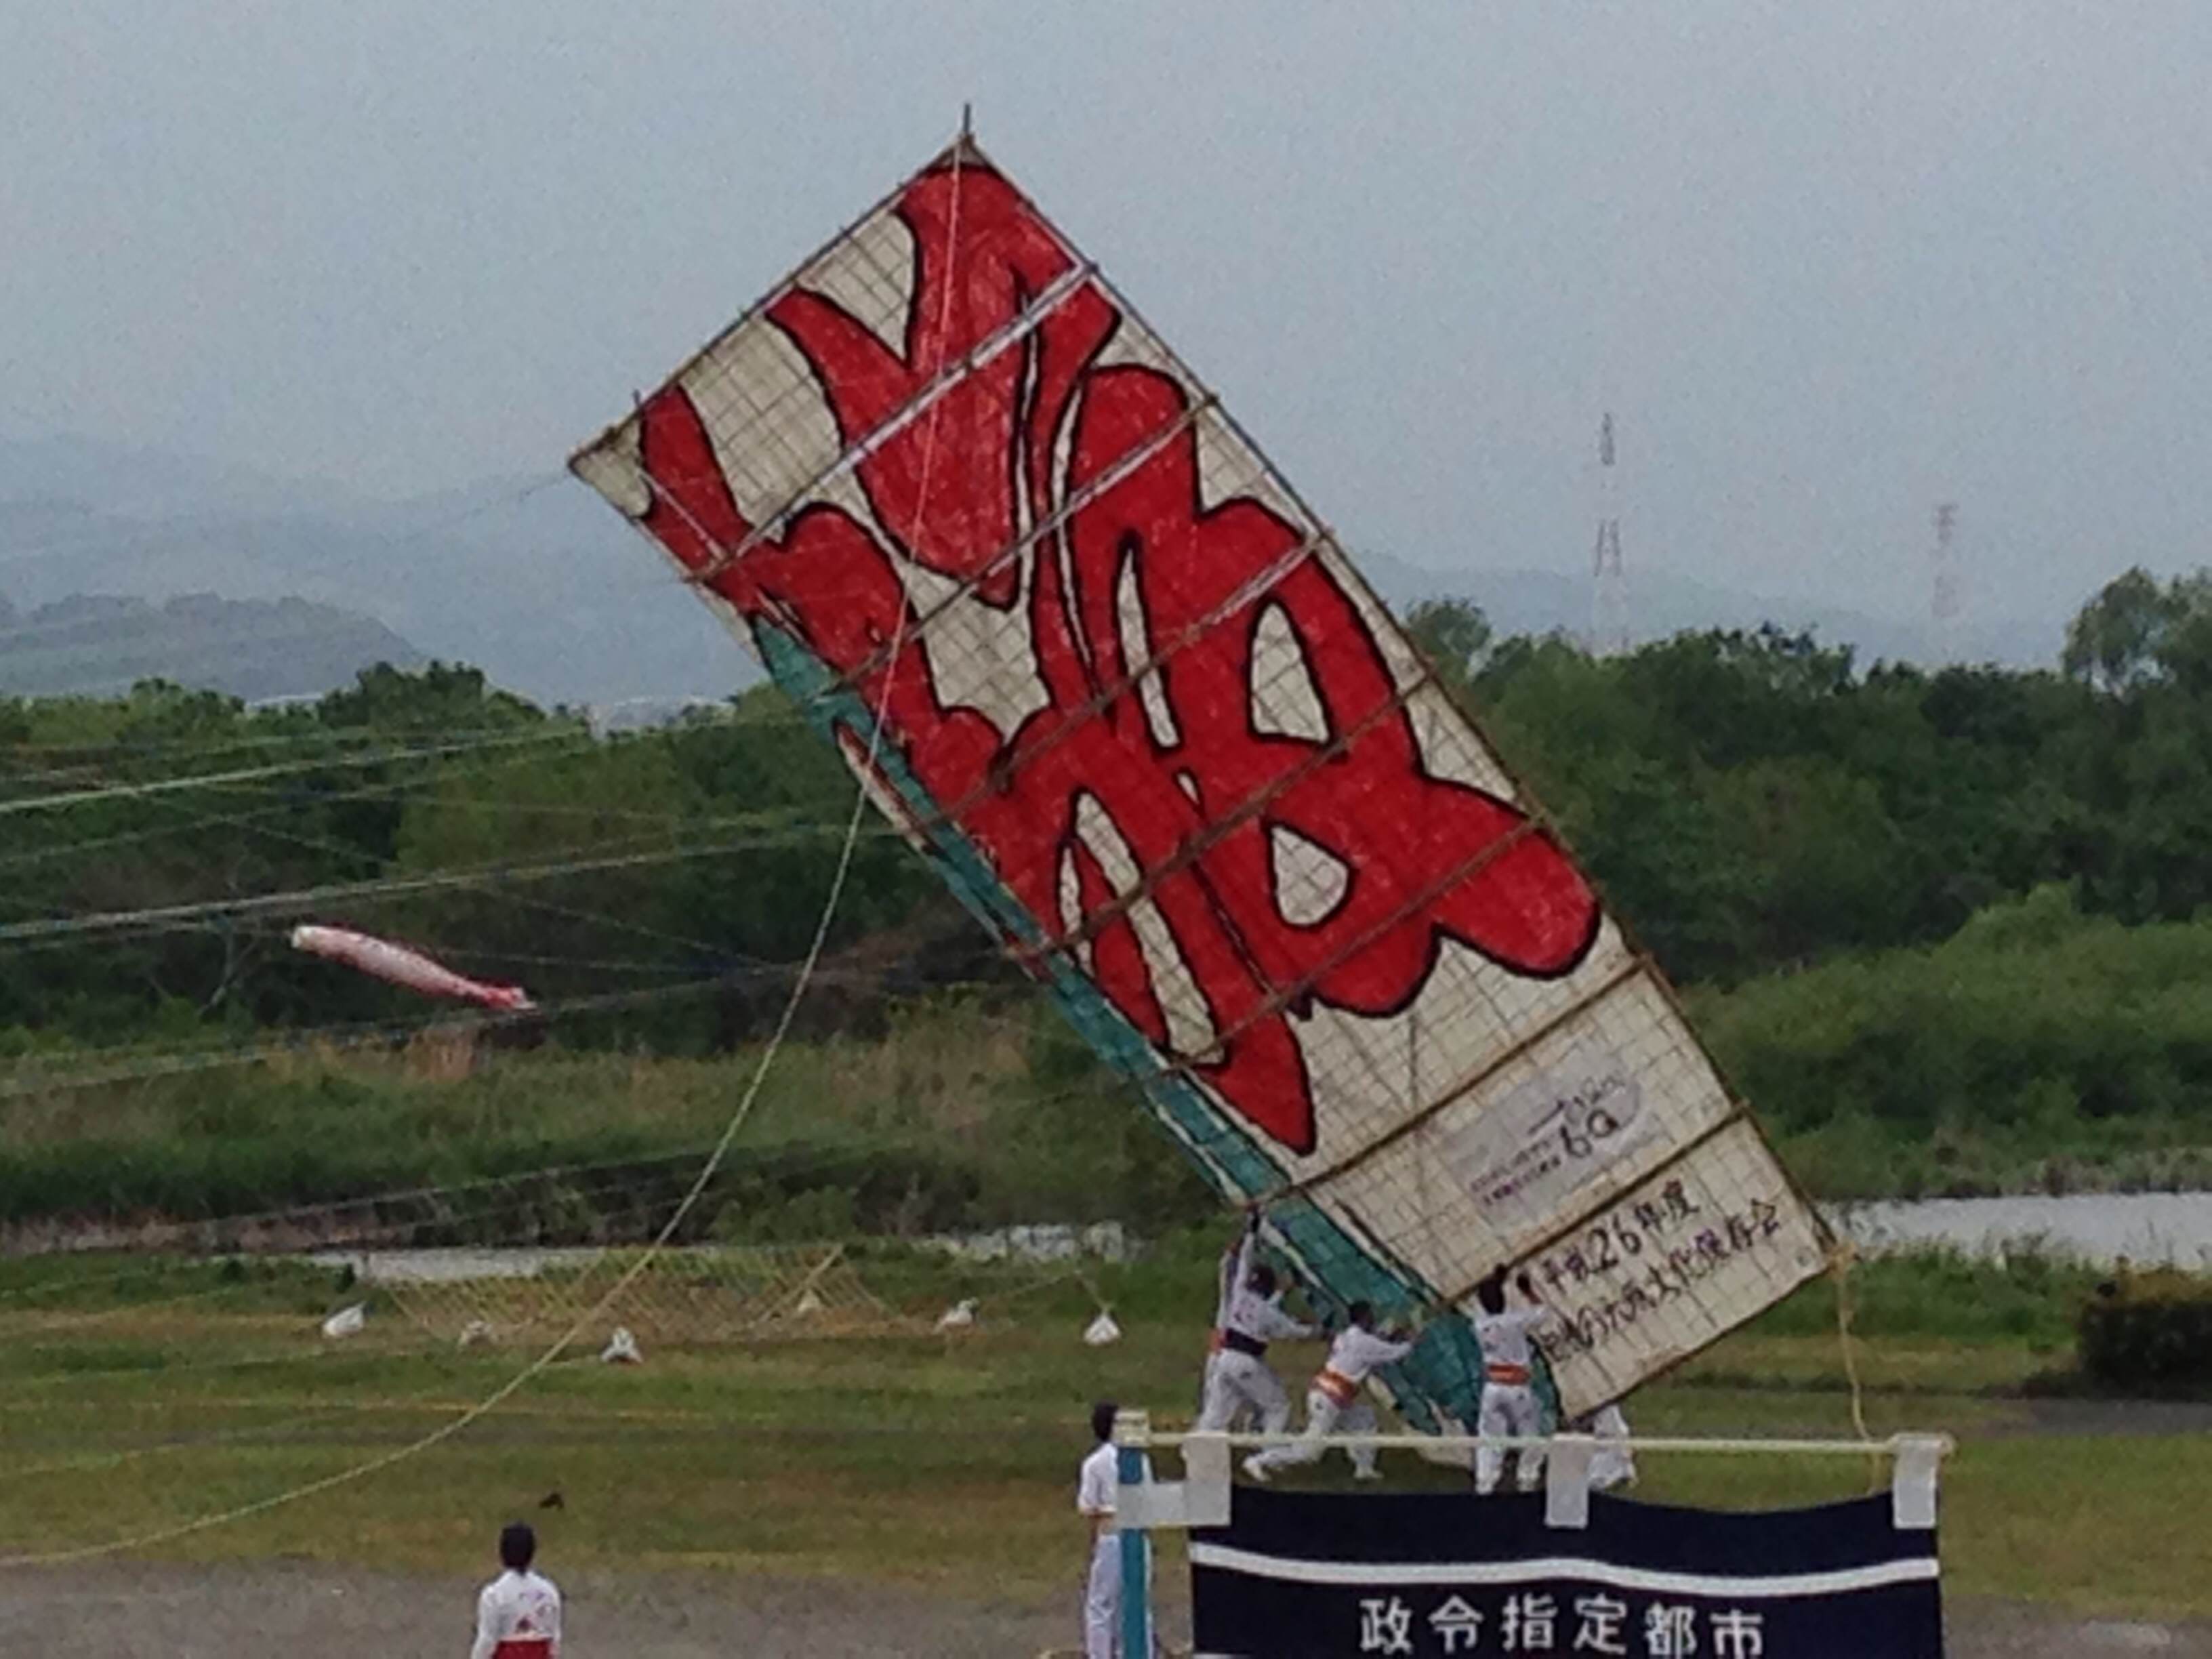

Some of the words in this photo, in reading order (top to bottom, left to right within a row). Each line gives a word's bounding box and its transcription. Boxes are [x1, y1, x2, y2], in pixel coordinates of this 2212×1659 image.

[1359, 1593, 1764, 1658] 政令指定都市
